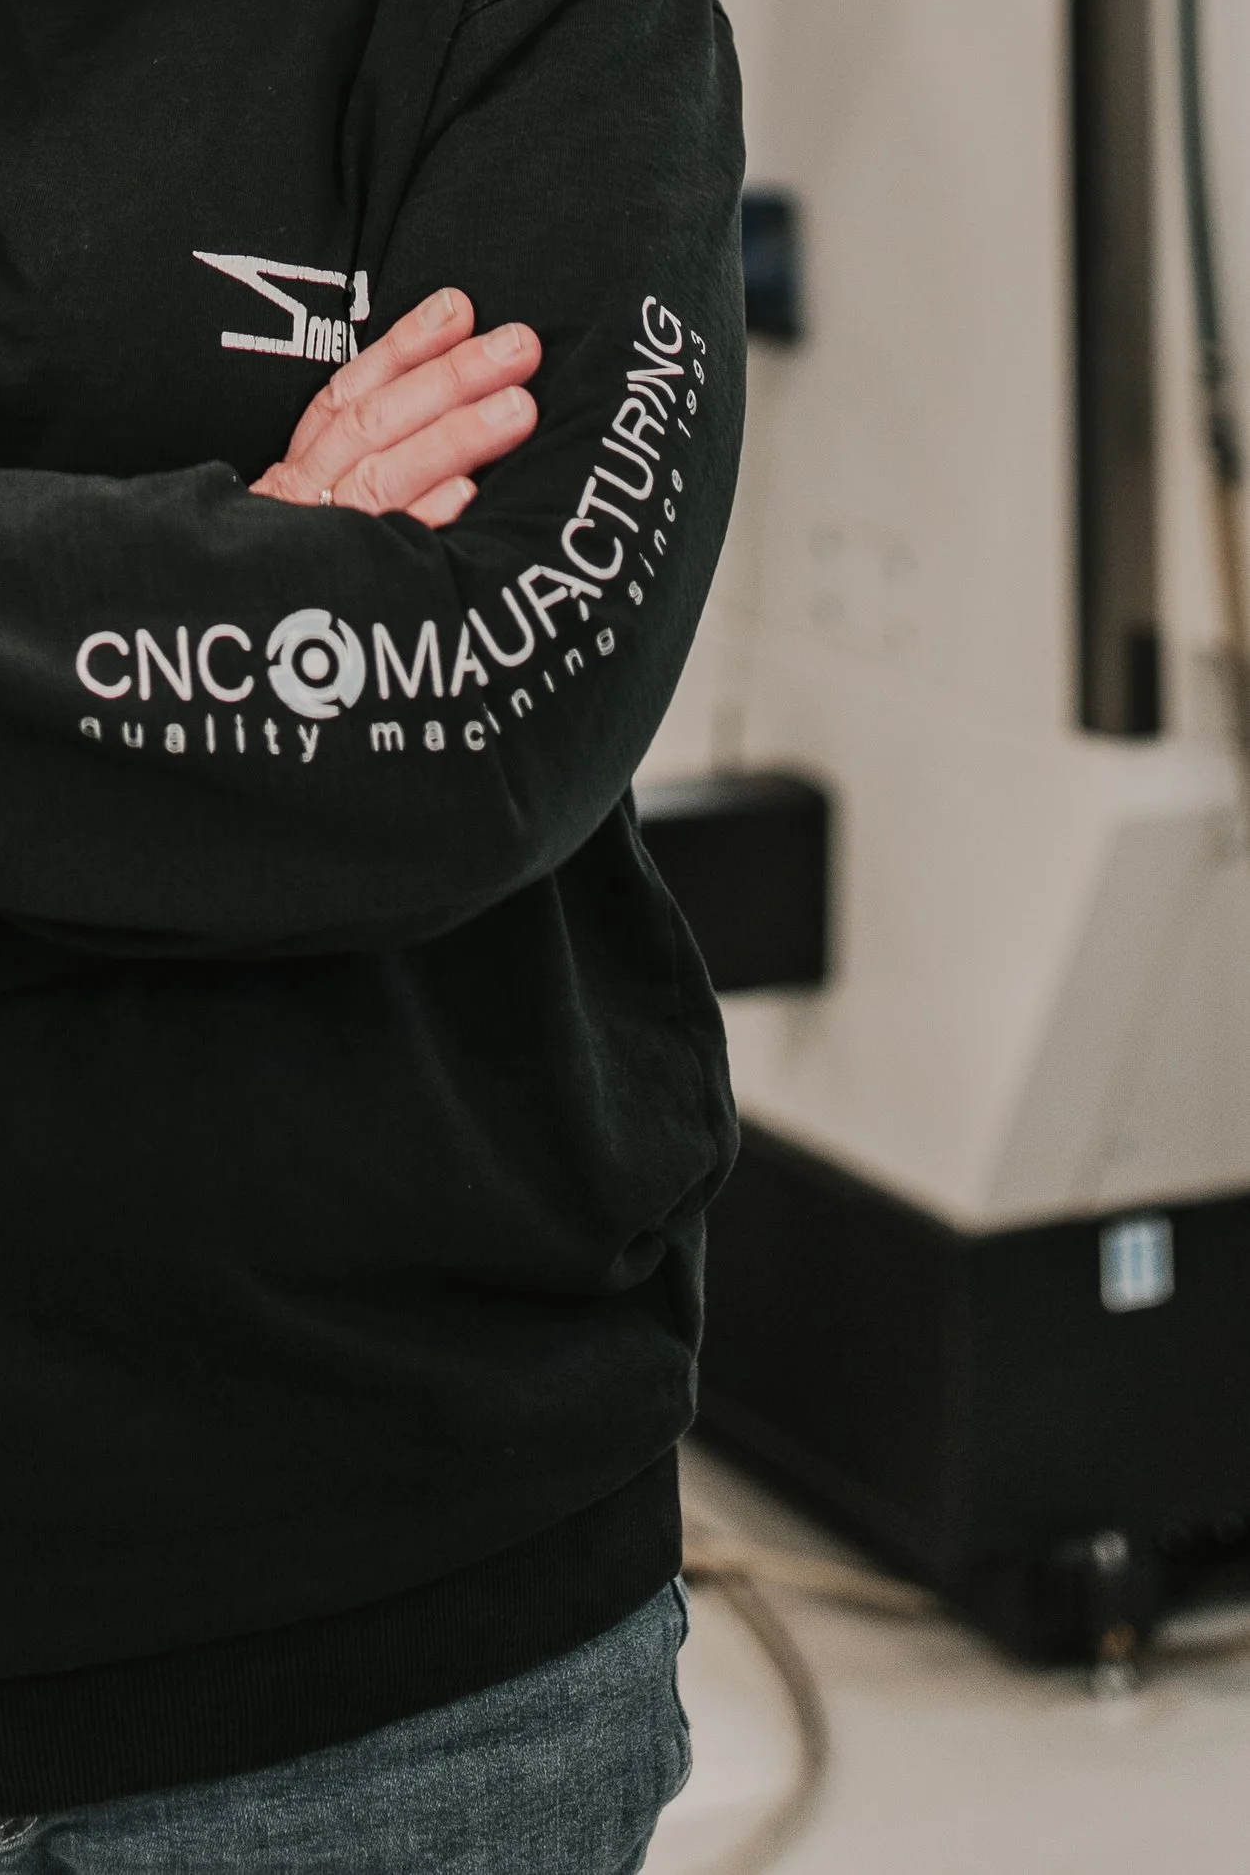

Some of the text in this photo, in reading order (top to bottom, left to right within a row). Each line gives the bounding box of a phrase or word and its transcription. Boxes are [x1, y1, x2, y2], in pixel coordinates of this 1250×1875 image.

[76, 295, 684, 701] CNC MAUFACTURING
[79, 329, 706, 763] quality macining since 1993
